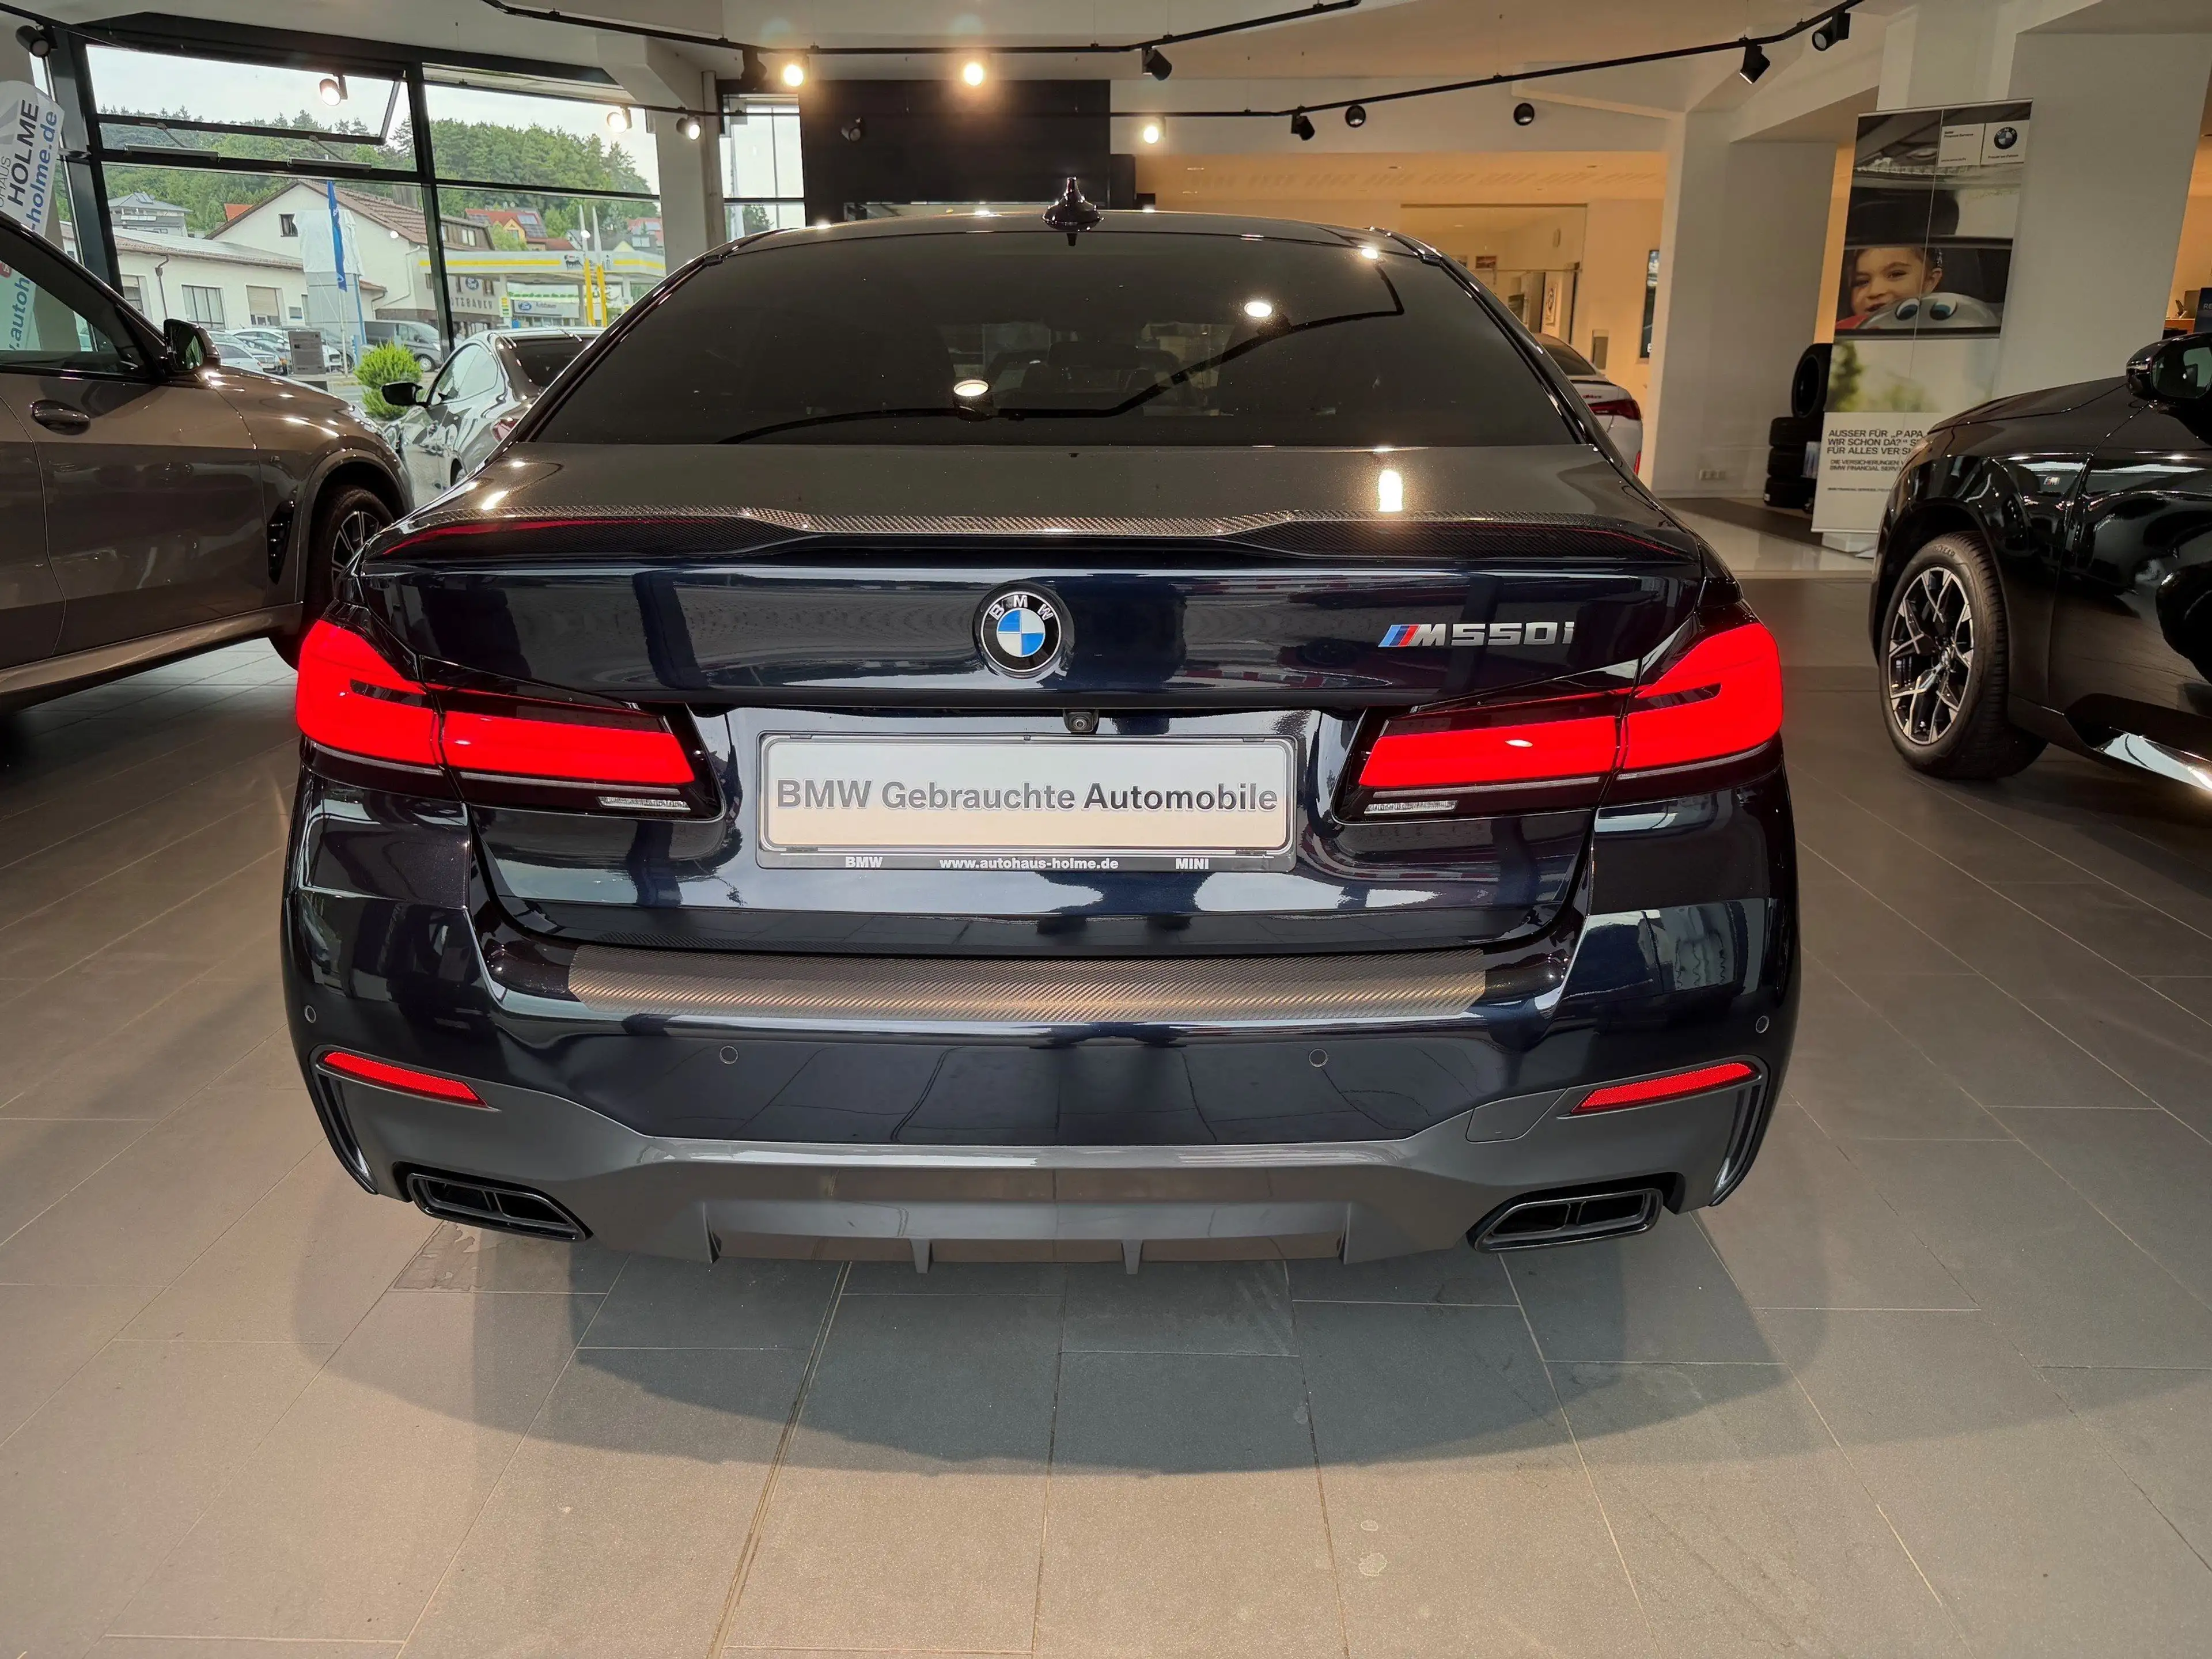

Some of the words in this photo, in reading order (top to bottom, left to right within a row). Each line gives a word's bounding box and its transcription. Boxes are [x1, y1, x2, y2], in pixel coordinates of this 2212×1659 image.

[7, 100, 39, 206] HOLME
[1869, 429, 1888, 437] FÜR
[989, 594, 1054, 620] BMW
[1406, 622, 1575, 647] M550i
[777, 779, 872, 808] BMW
[881, 781, 1075, 809] Gebrauchte
[1083, 782, 1278, 810] Automobile
[844, 857, 883, 868] BMW
[939, 857, 1119, 870] www.autohaus-holme.de
[1175, 858, 1209, 870] MINI
